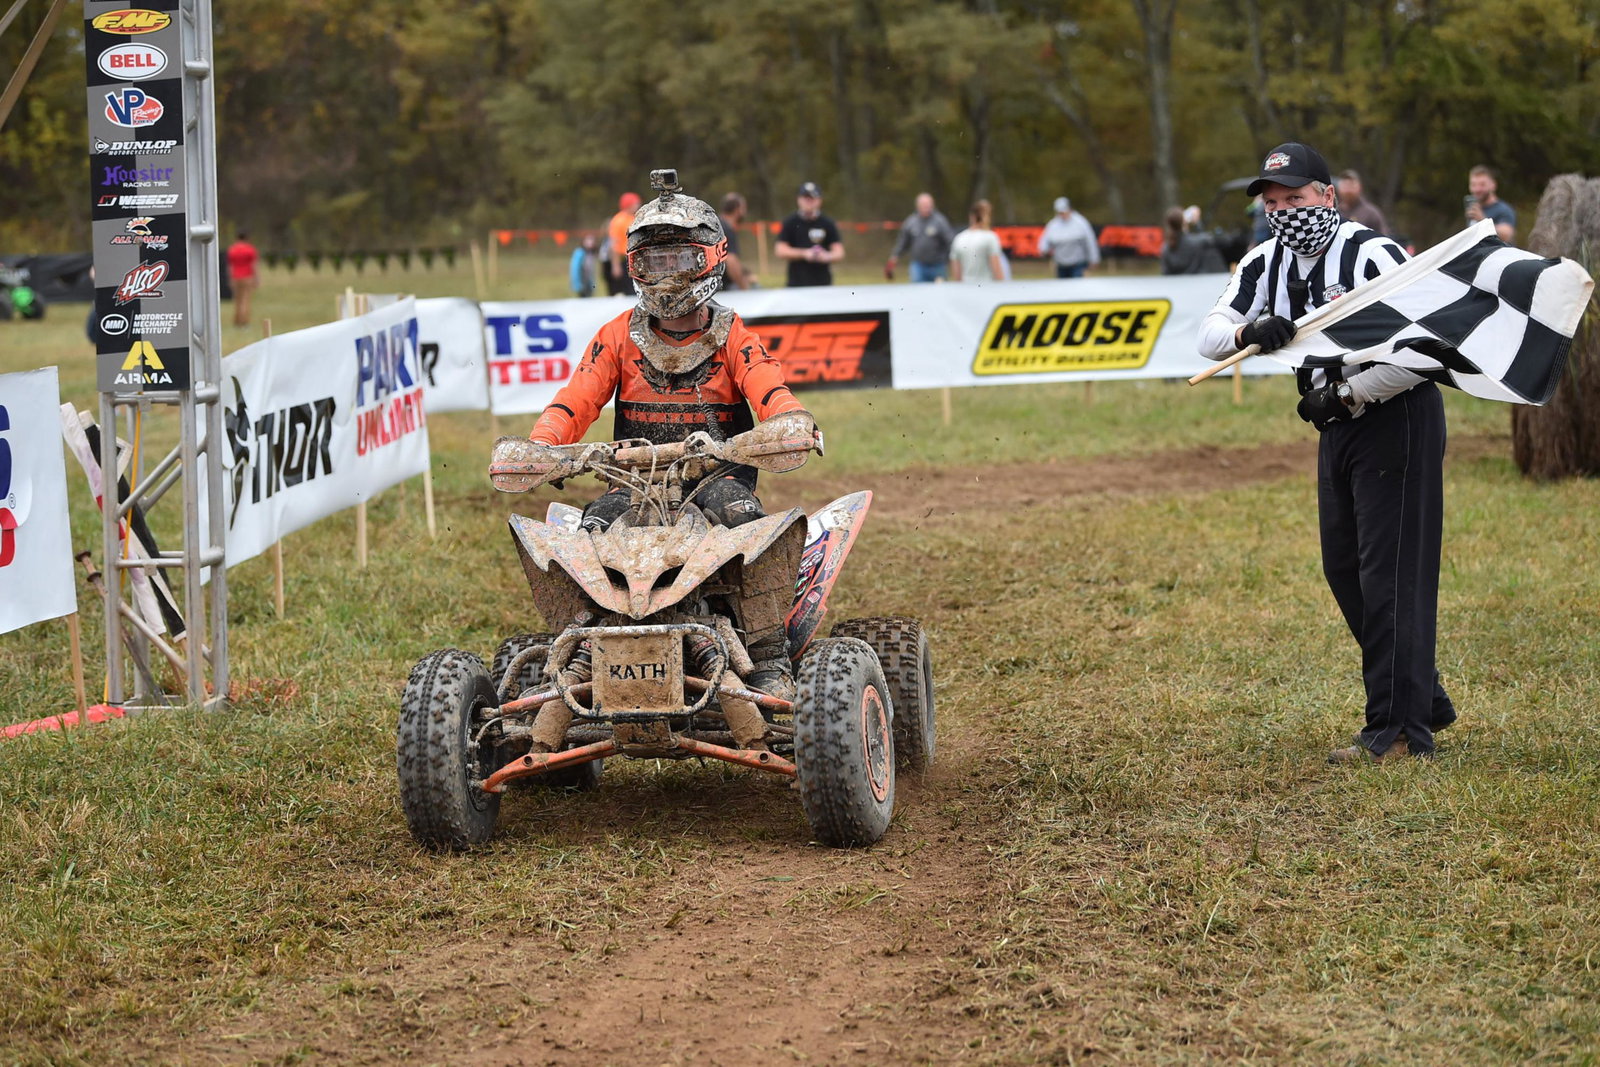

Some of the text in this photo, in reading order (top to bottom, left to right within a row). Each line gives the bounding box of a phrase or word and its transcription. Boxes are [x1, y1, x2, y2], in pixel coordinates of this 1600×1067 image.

[93, 12, 170, 29] FMF
[110, 53, 157, 68] BELL
[106, 88, 146, 125] VP
[111, 140, 177, 149] DUNLOP
[101, 163, 174, 186] Hoosier
[110, 235, 132, 245] ALL
[134, 312, 183, 321] MOTORCYCLE
[105, 319, 124, 329] MMI
[133, 320, 178, 328] MECHANICS
[132, 326, 172, 334] INSTITUTE
[990, 310, 1157, 350] MOOSE
[114, 372, 173, 385] ARMA
